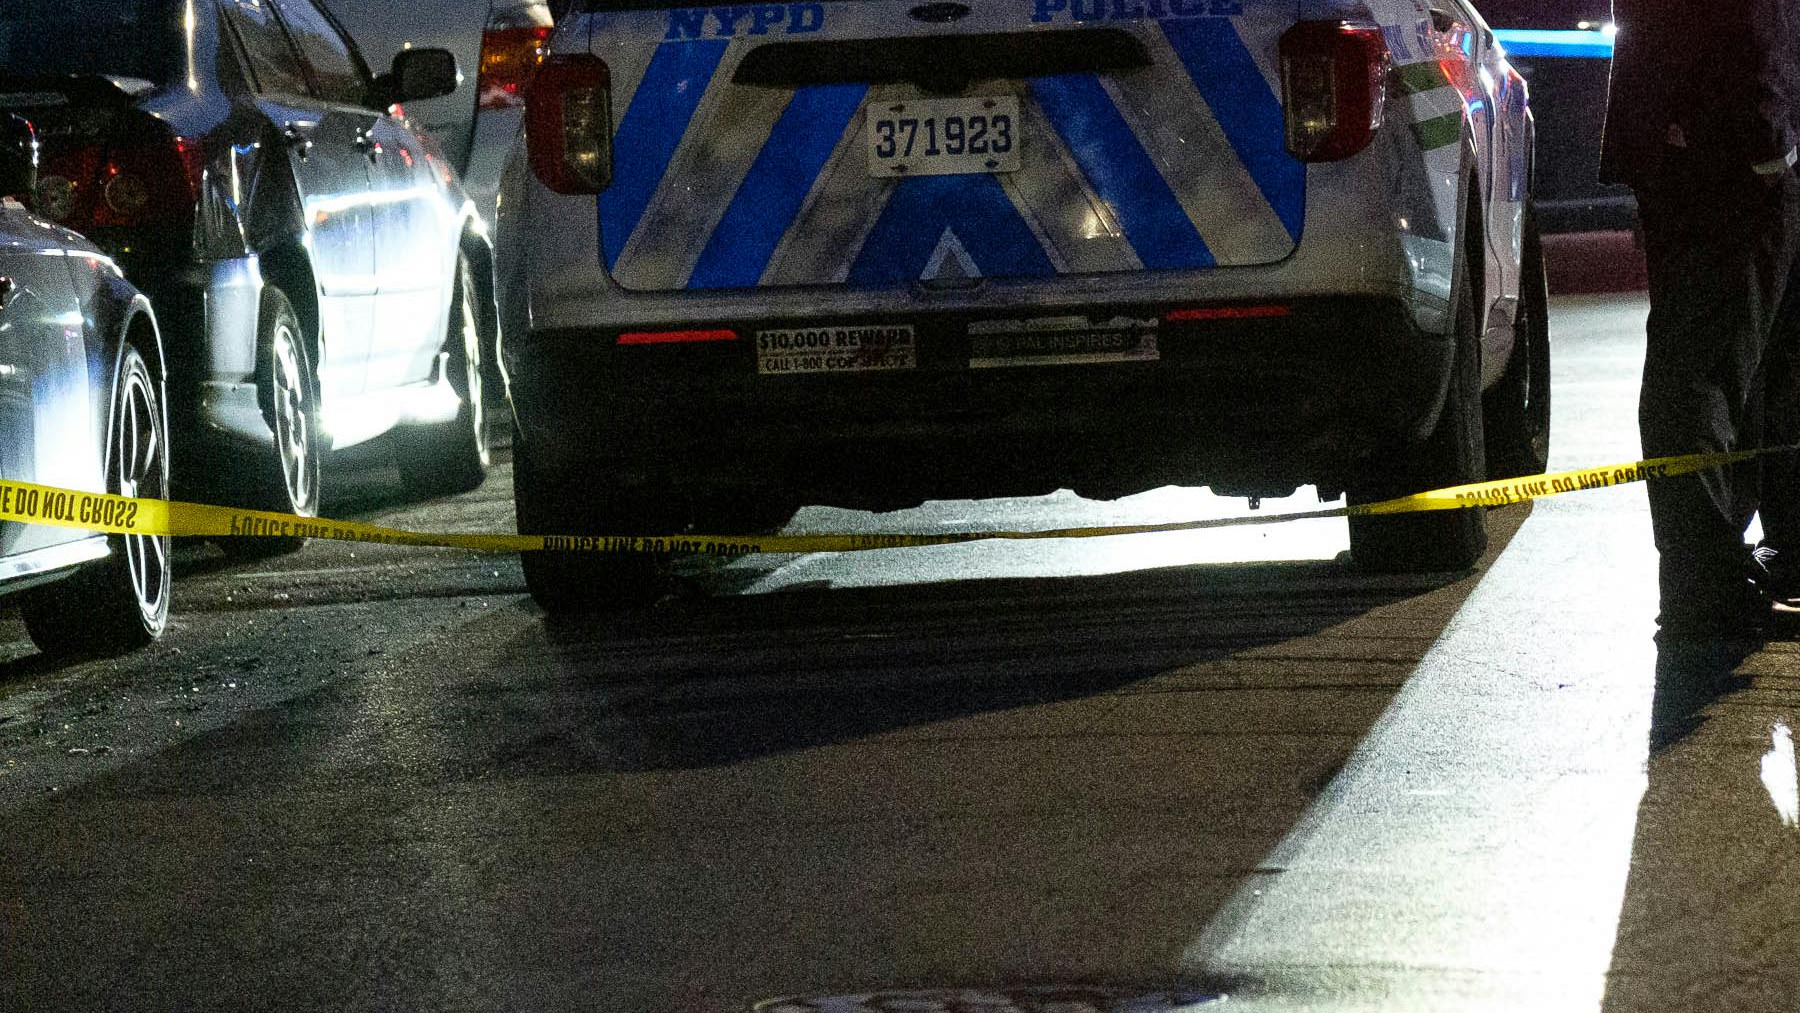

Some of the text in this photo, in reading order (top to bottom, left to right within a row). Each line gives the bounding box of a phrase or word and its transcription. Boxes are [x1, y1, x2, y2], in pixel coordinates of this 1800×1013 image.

[664, 2, 825, 40] NYPD
[875, 114, 1013, 159] 371923
[760, 329, 910, 349] $10,000 REWARD
[765, 358, 790, 371] CALL
